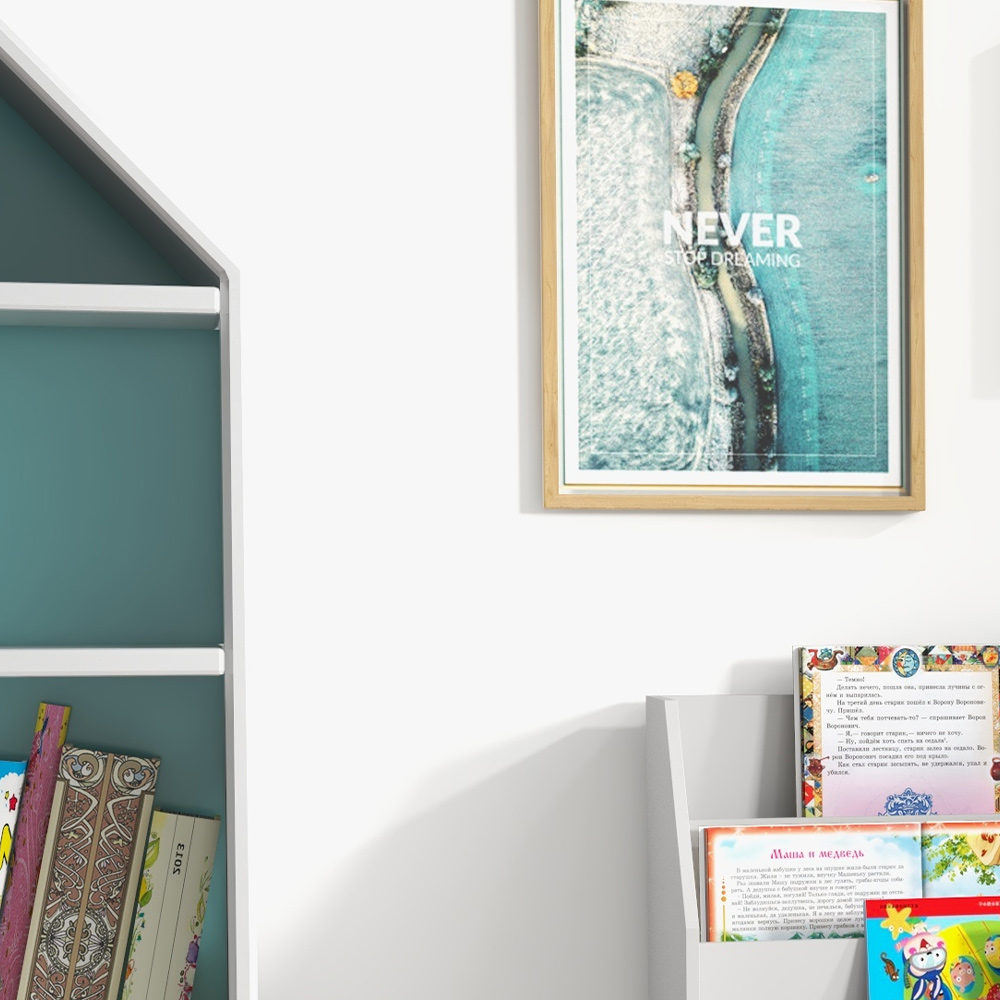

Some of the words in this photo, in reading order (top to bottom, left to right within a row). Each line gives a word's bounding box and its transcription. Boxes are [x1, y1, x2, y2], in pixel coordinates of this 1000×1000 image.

[663, 211, 802, 248] NEVER
[665, 251, 707, 265] STOP
[712, 252, 800, 268] DREAMING
[770, 849, 804, 859] Маша
[819, 850, 864, 859] медведь
